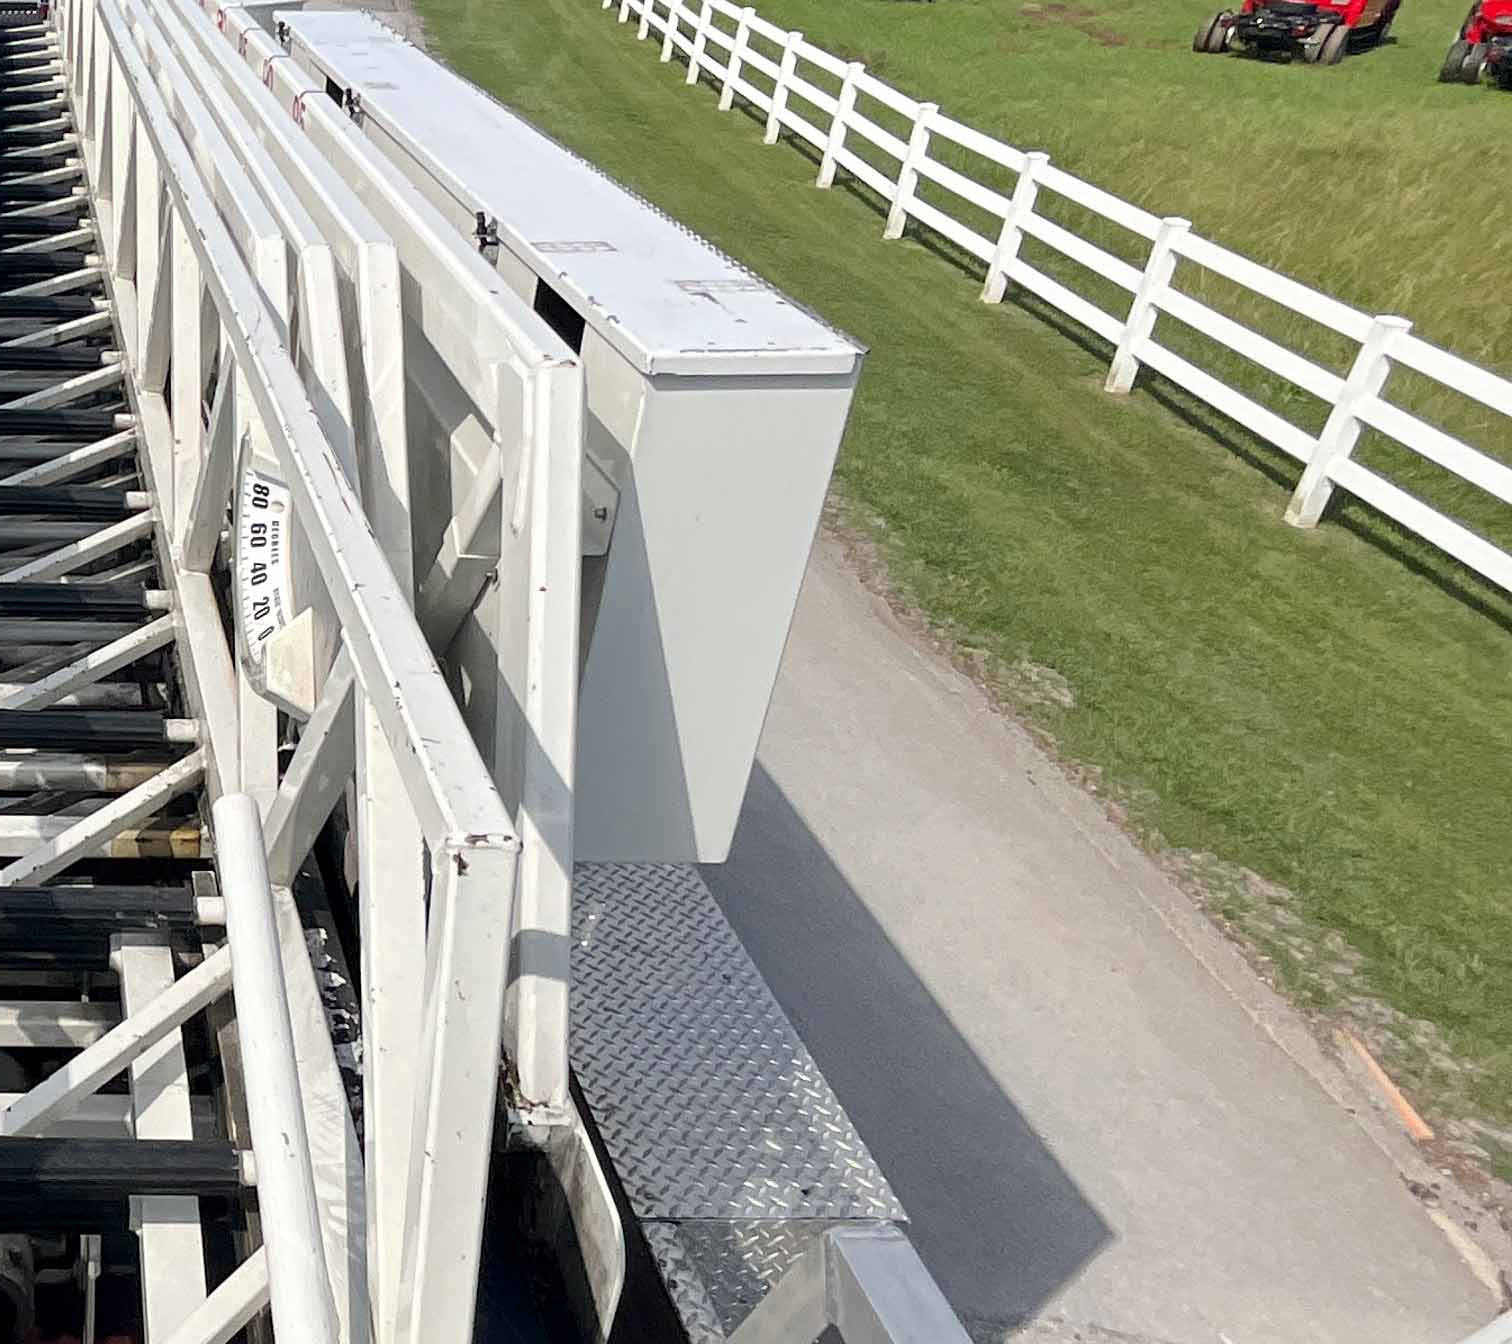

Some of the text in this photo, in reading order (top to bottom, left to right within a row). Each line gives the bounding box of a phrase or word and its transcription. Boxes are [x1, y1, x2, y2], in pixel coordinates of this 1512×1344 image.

[250, 483, 275, 641] 80 60 40 20 0
